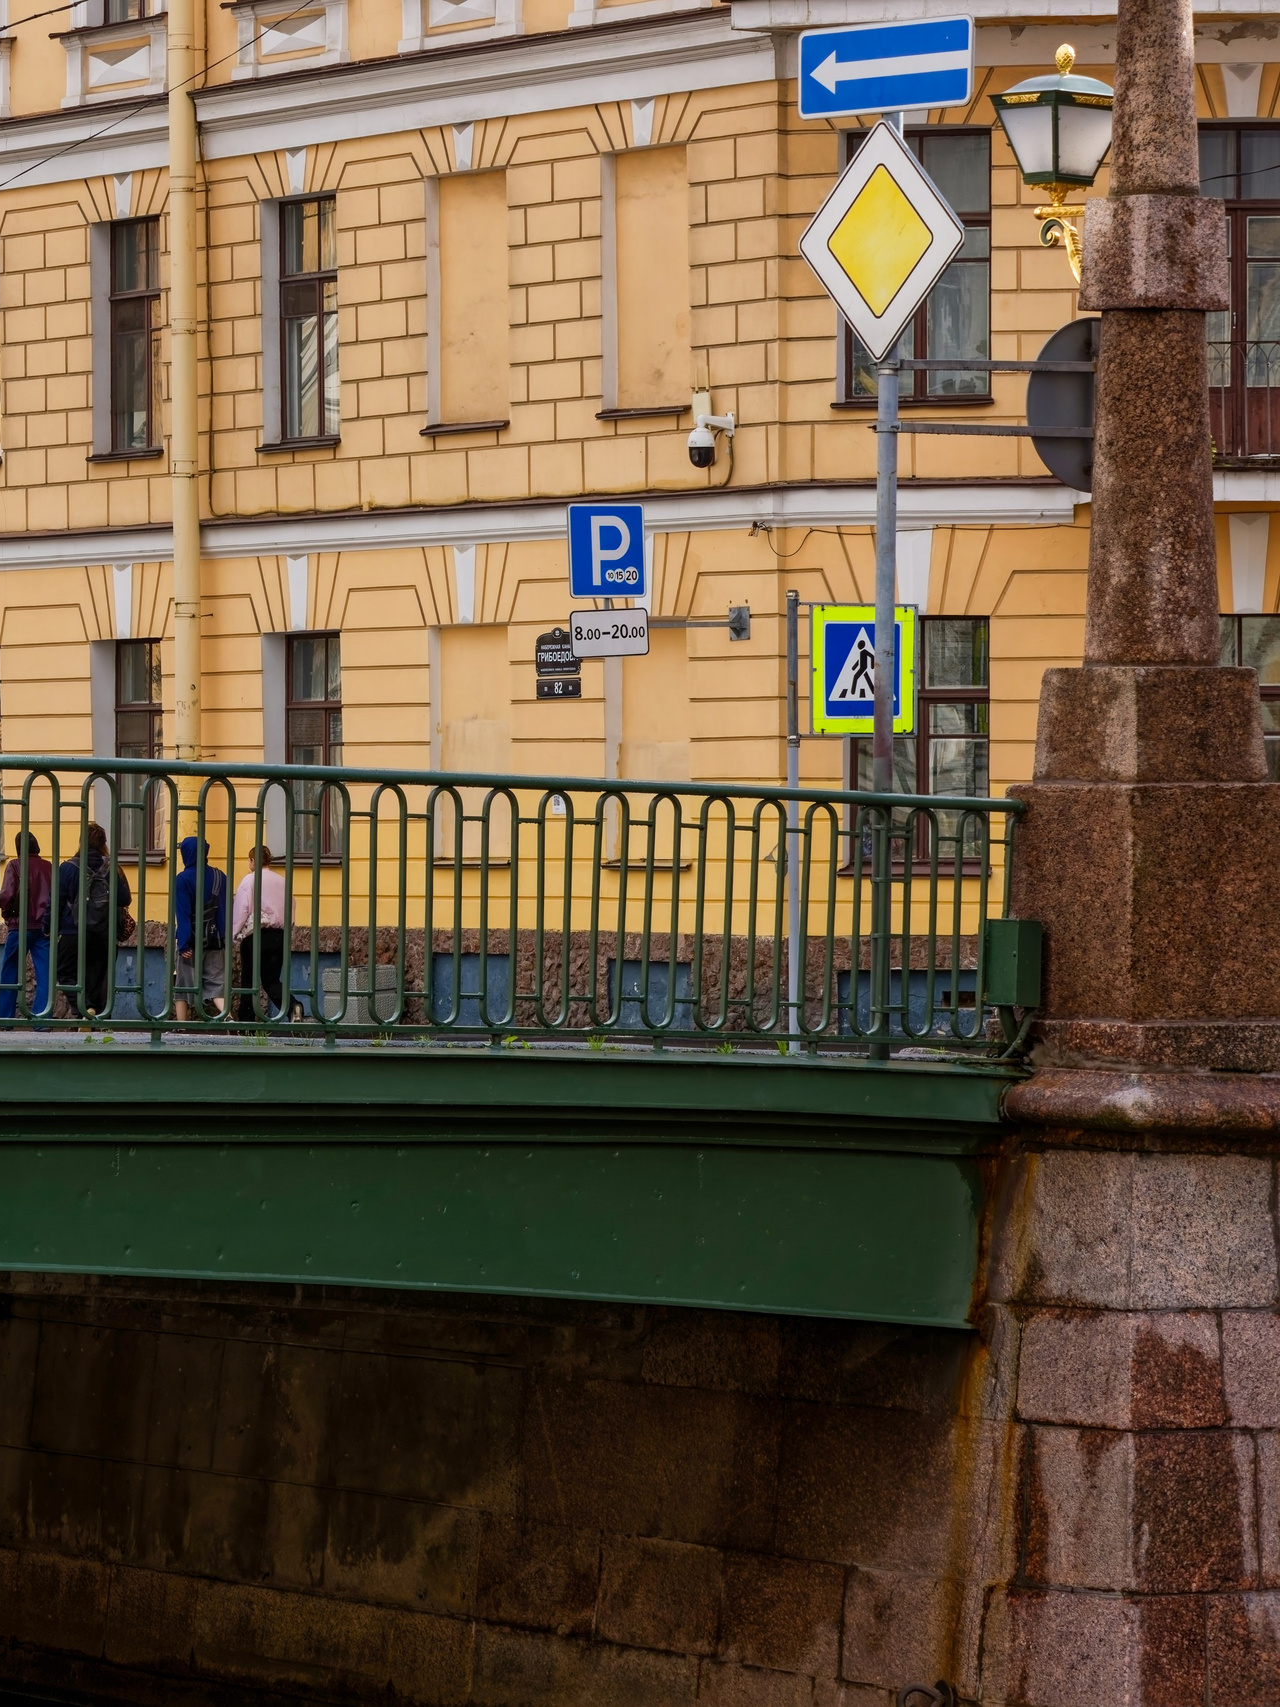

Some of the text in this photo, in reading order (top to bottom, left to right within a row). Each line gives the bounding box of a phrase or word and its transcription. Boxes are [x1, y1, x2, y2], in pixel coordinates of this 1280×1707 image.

[590, 515, 631, 586] P
[607, 570, 638, 581] 10 15 20
[537, 651, 579, 663] ГРИБОЕДОВ
[554, 681, 563, 694] 82
